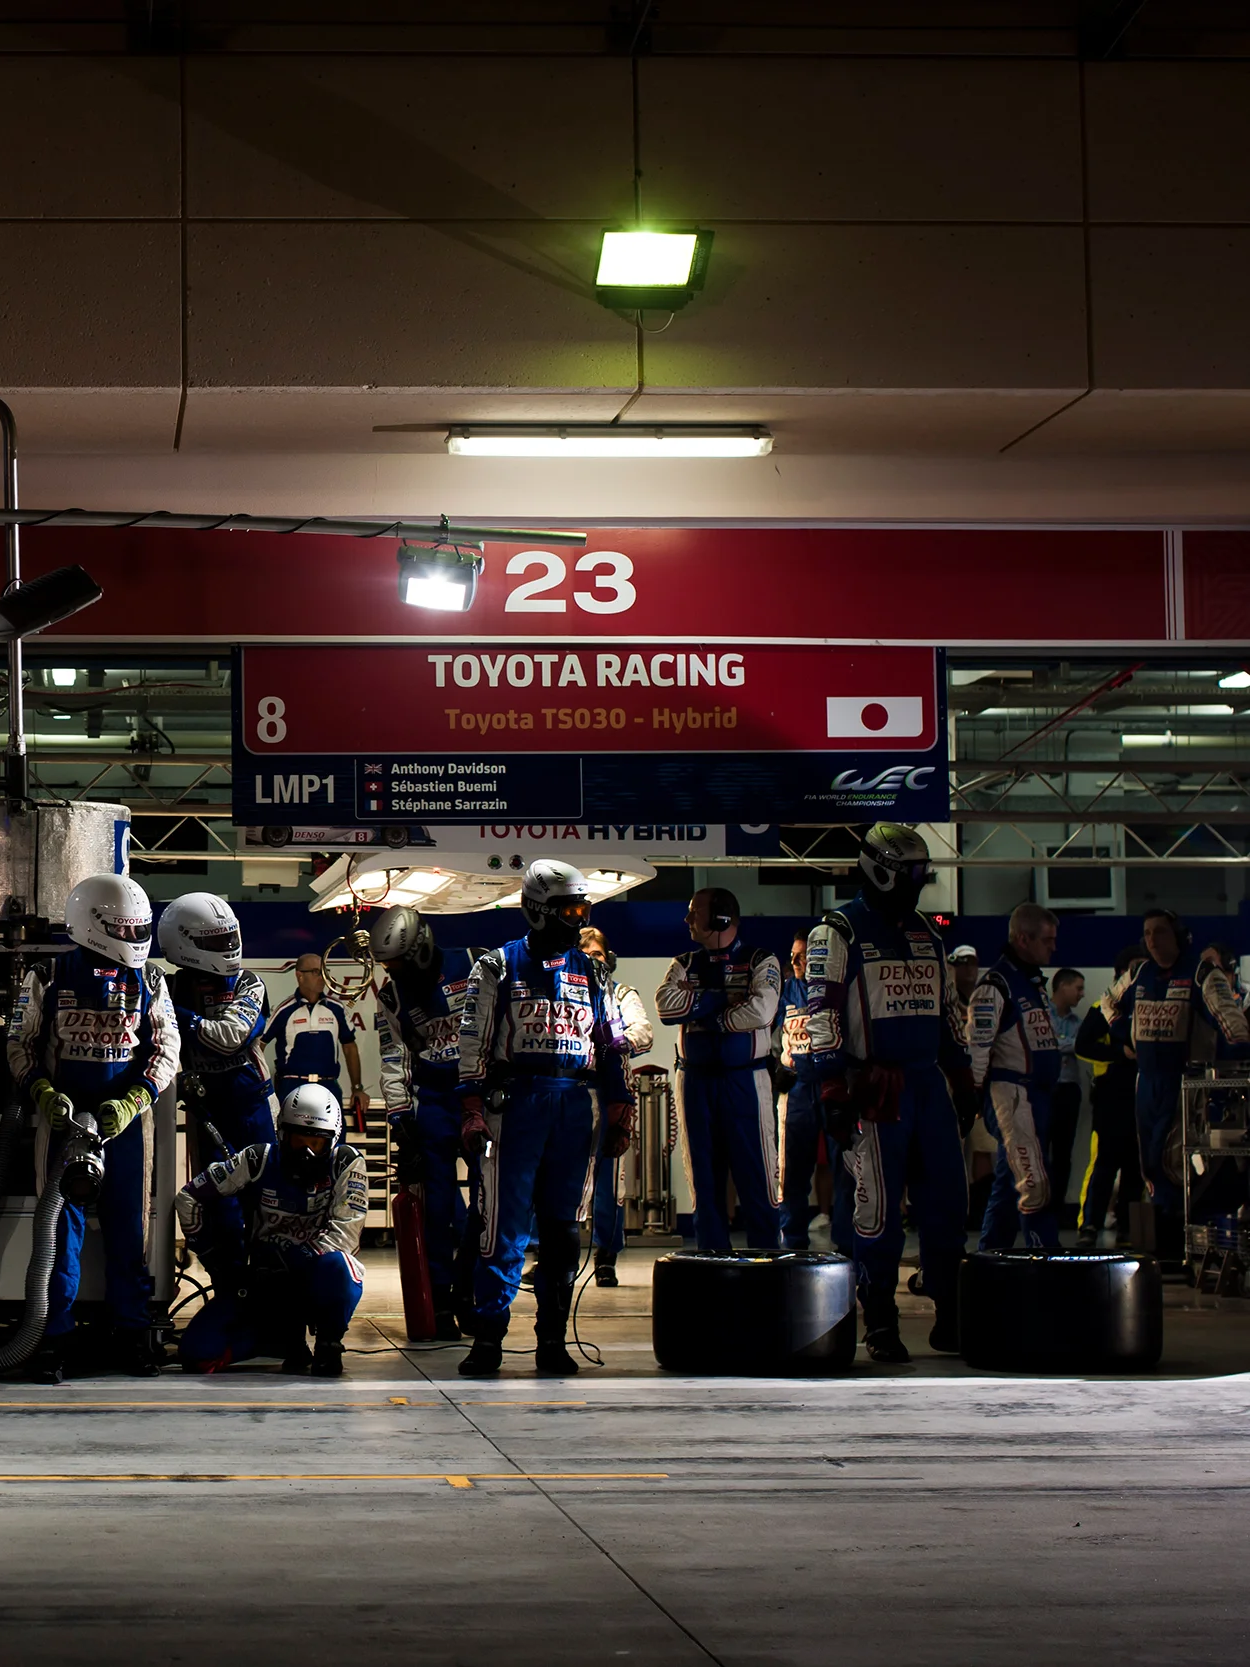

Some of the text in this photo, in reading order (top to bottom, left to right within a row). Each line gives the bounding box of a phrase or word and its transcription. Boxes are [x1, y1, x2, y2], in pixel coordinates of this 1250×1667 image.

[505, 551, 636, 614] 23
[428, 653, 745, 687] TOYOTA RACING
[257, 696, 287, 743] 8
[444, 708, 534, 735] Toyota
[542, 708, 626, 730] TS030
[652, 706, 737, 735] Hybrid
[391, 763, 507, 777] Anthony Davidson
[830, 765, 936, 791] WEC
[255, 774, 335, 804] LMP1
[391, 780, 497, 793] Sébastien Buemi
[391, 798, 508, 812] Stéphane Sarrazin
[294, 831, 365, 842] DENSO 8
[479, 824, 707, 841] TOYOTA HYBRID
[536, 873, 550, 893] uvex
[527, 899, 559, 917] uvex
[200, 927, 228, 936] TOYOTA
[87, 938, 108, 951] uvex
[180, 956, 200, 965] uvex
[880, 965, 935, 981] DENSO
[451, 979, 468, 991] TOTA
[885, 983, 935, 996] TOYOTA
[518, 1003, 587, 1021] DENSO
[886, 999, 935, 1012] HYBRID
[1137, 1004, 1179, 1016] DENSO
[64, 1012, 135, 1027] DENSO
[1139, 1018, 1174, 1028] TOYOTA
[522, 1023, 580, 1037] TOYOTA
[69, 1032, 132, 1044] TOYOTA
[522, 1039, 582, 1051] HYBRID
[69, 1045, 130, 1058] HYBRID
[194, 1053, 246, 1072] HYBRID
[1017, 1146, 1035, 1189] DENSO
